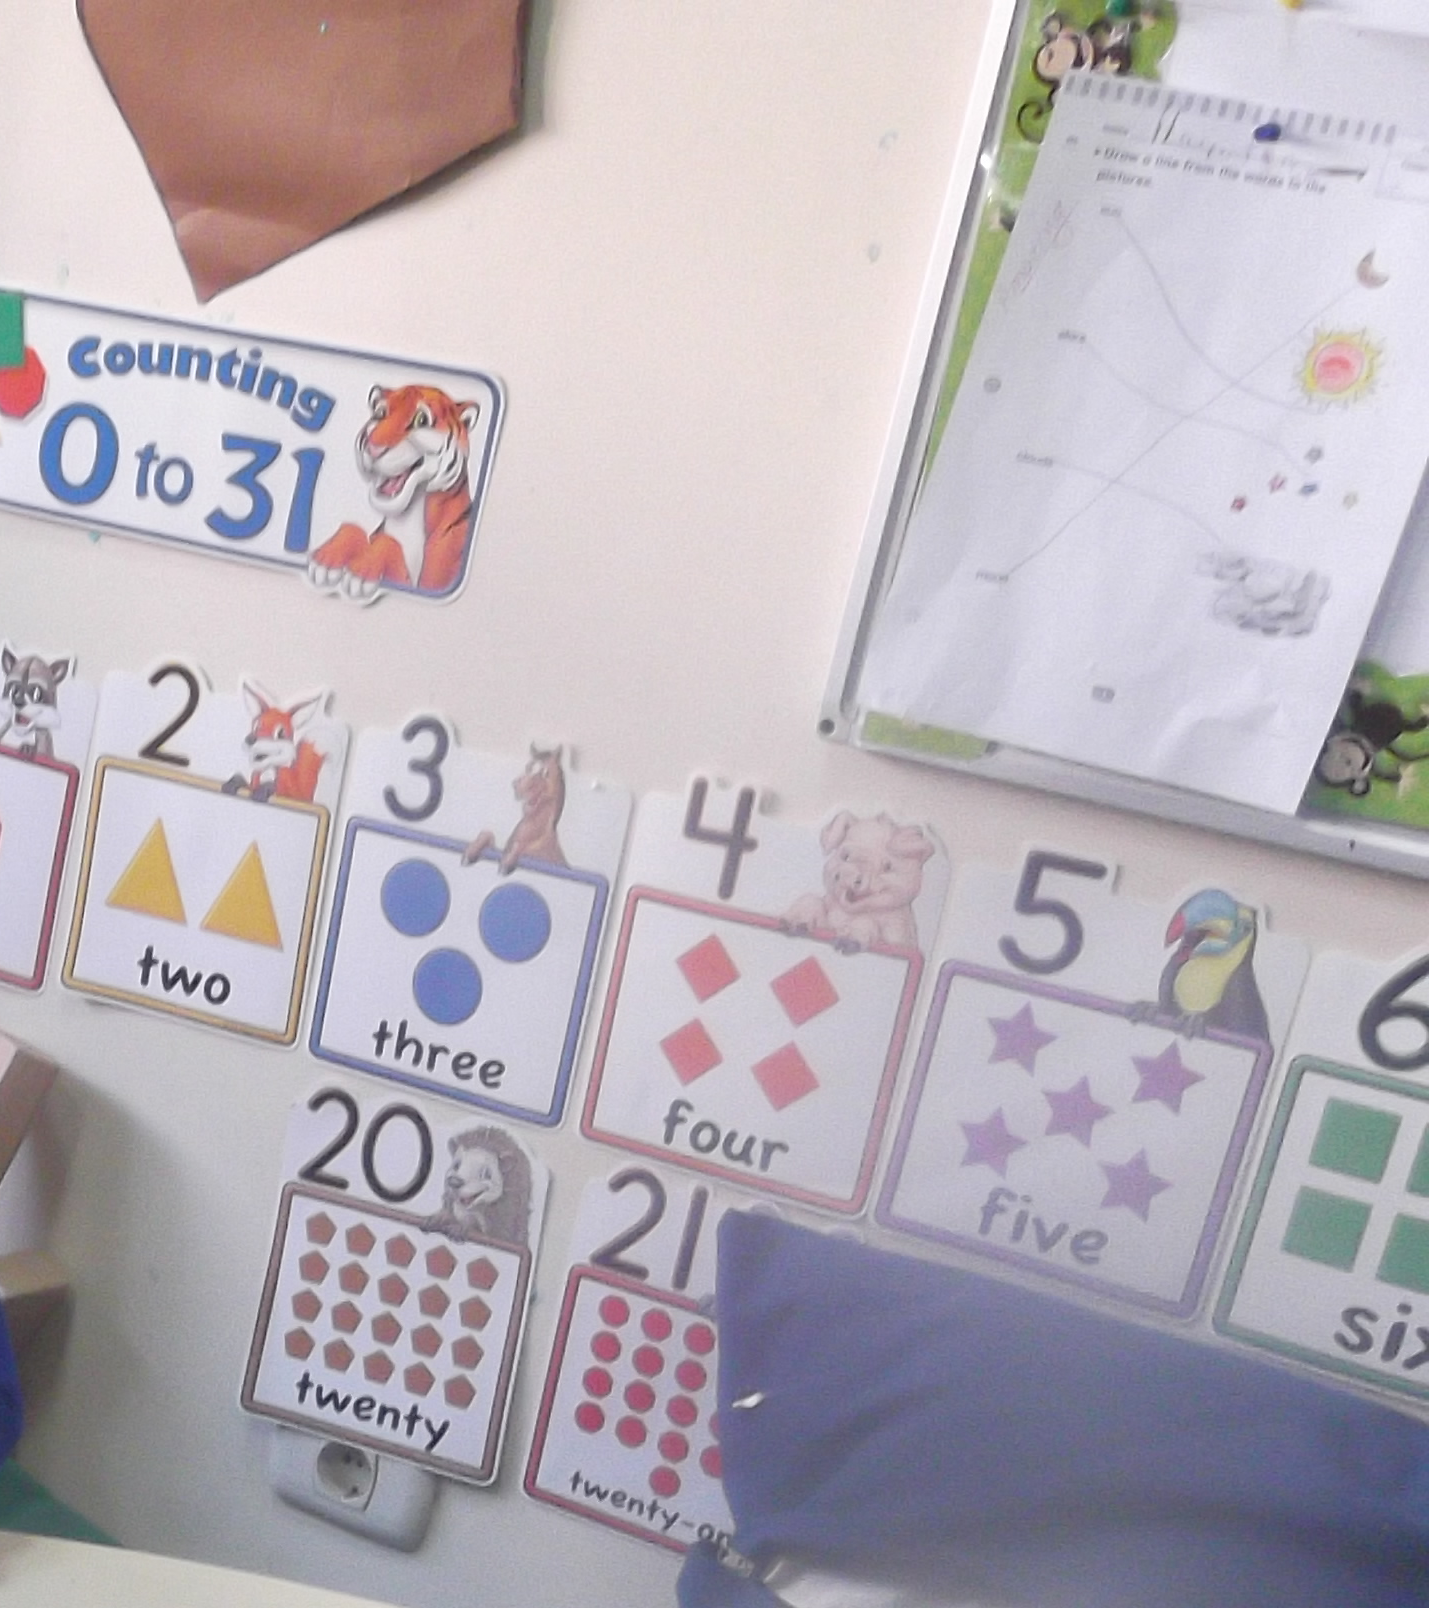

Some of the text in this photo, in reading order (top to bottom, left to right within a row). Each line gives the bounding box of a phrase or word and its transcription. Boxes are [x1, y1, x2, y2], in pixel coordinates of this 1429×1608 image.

[38, 401, 326, 553] 0 to 31
[138, 663, 201, 768] 2
[382, 714, 450, 822] 3
[683, 776, 758, 900] 4
[998, 849, 1108, 975] 5
[136, 945, 232, 1006] two
[1357, 953, 1429, 1072] 6
[371, 1018, 506, 1089] three
[297, 1086, 435, 1204] 20
[662, 1098, 789, 1173] four
[588, 1166, 710, 1292] 21
[977, 1187, 1109, 1265] five
[294, 1371, 451, 1452] twenty
